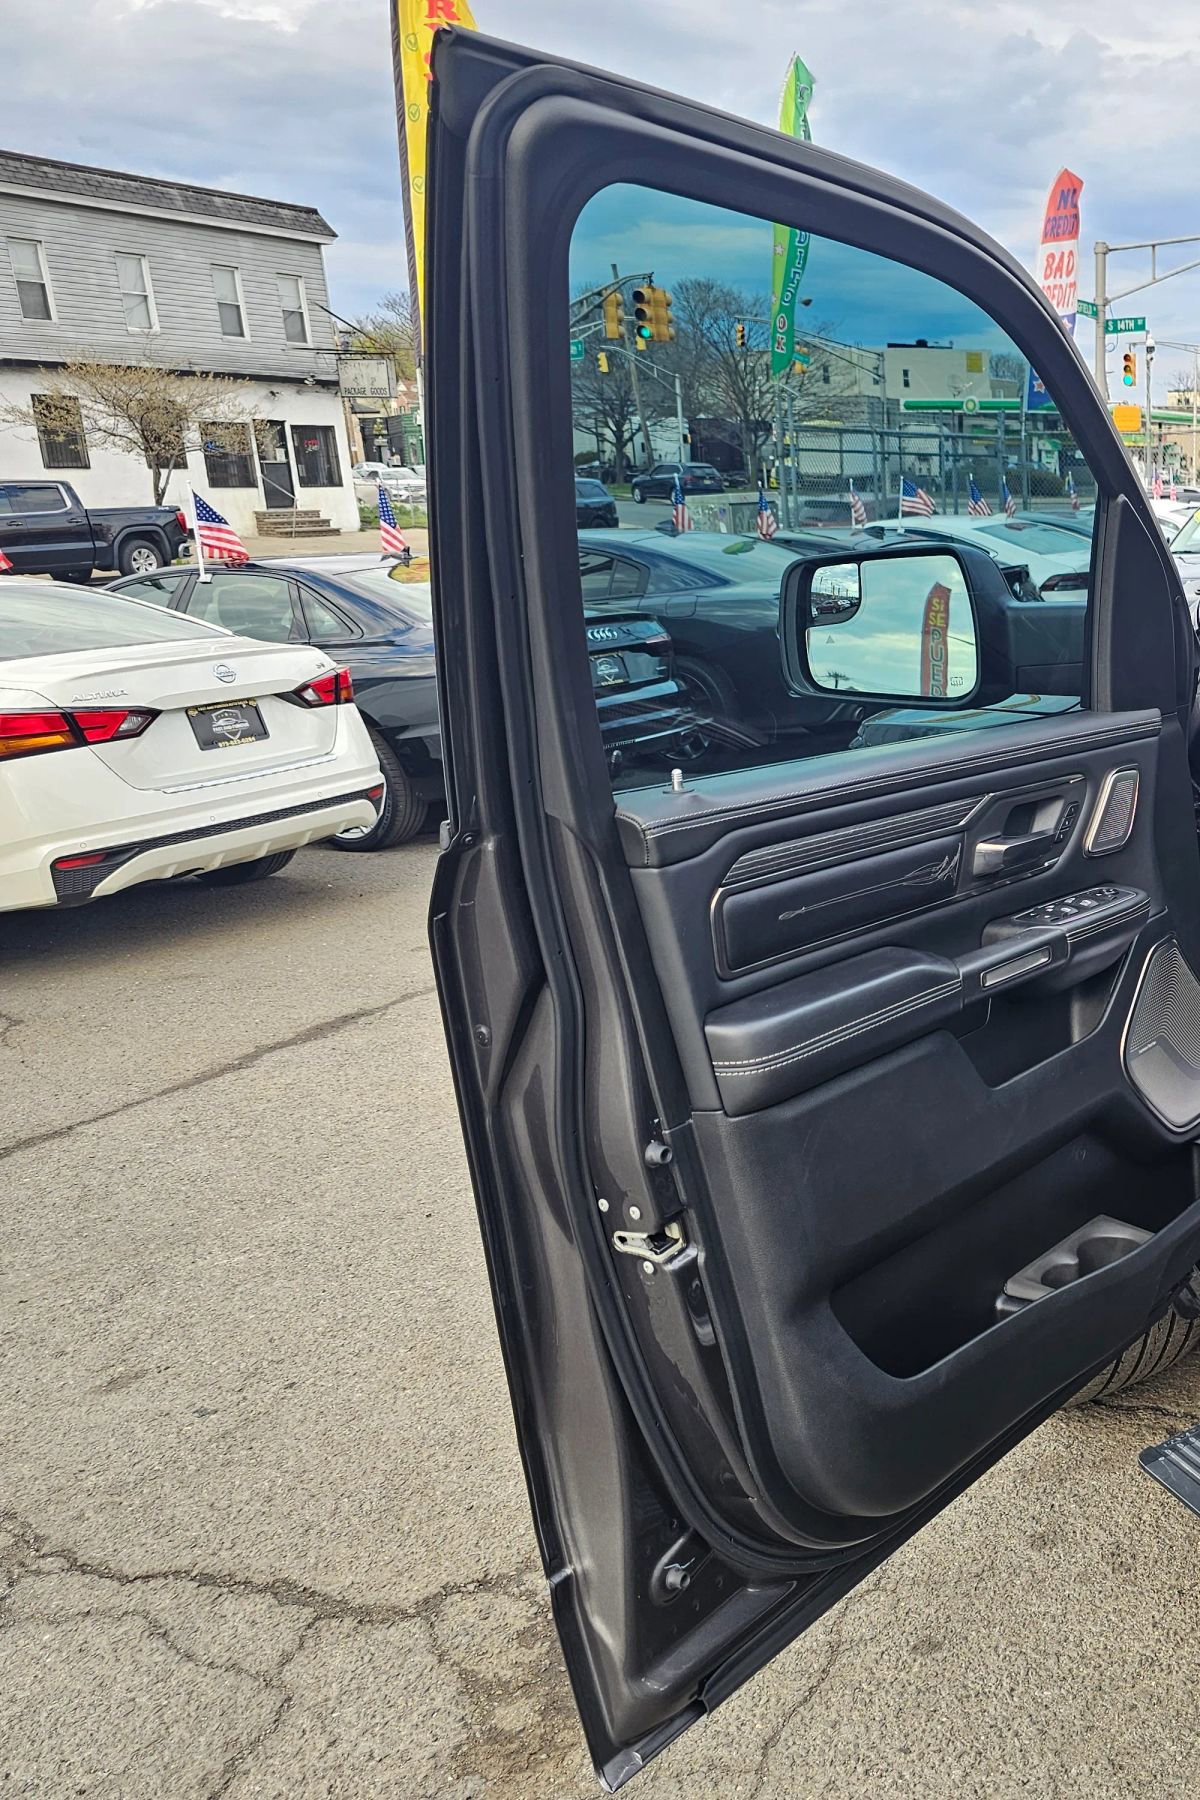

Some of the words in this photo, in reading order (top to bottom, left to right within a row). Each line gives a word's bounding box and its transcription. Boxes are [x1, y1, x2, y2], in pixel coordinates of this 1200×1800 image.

[1043, 249, 1075, 281] BAD
[1108, 321, 1114, 331] S
[1117, 319, 1135, 331] 14TH
[776, 313, 788, 354] OK
[344, 387, 367, 396] PACKAGE
[370, 387, 388, 396] GOODS
[929, 612, 945, 626] SE
[930, 626, 945, 697] PUED
[72, 689, 129, 703] ALTIMA
